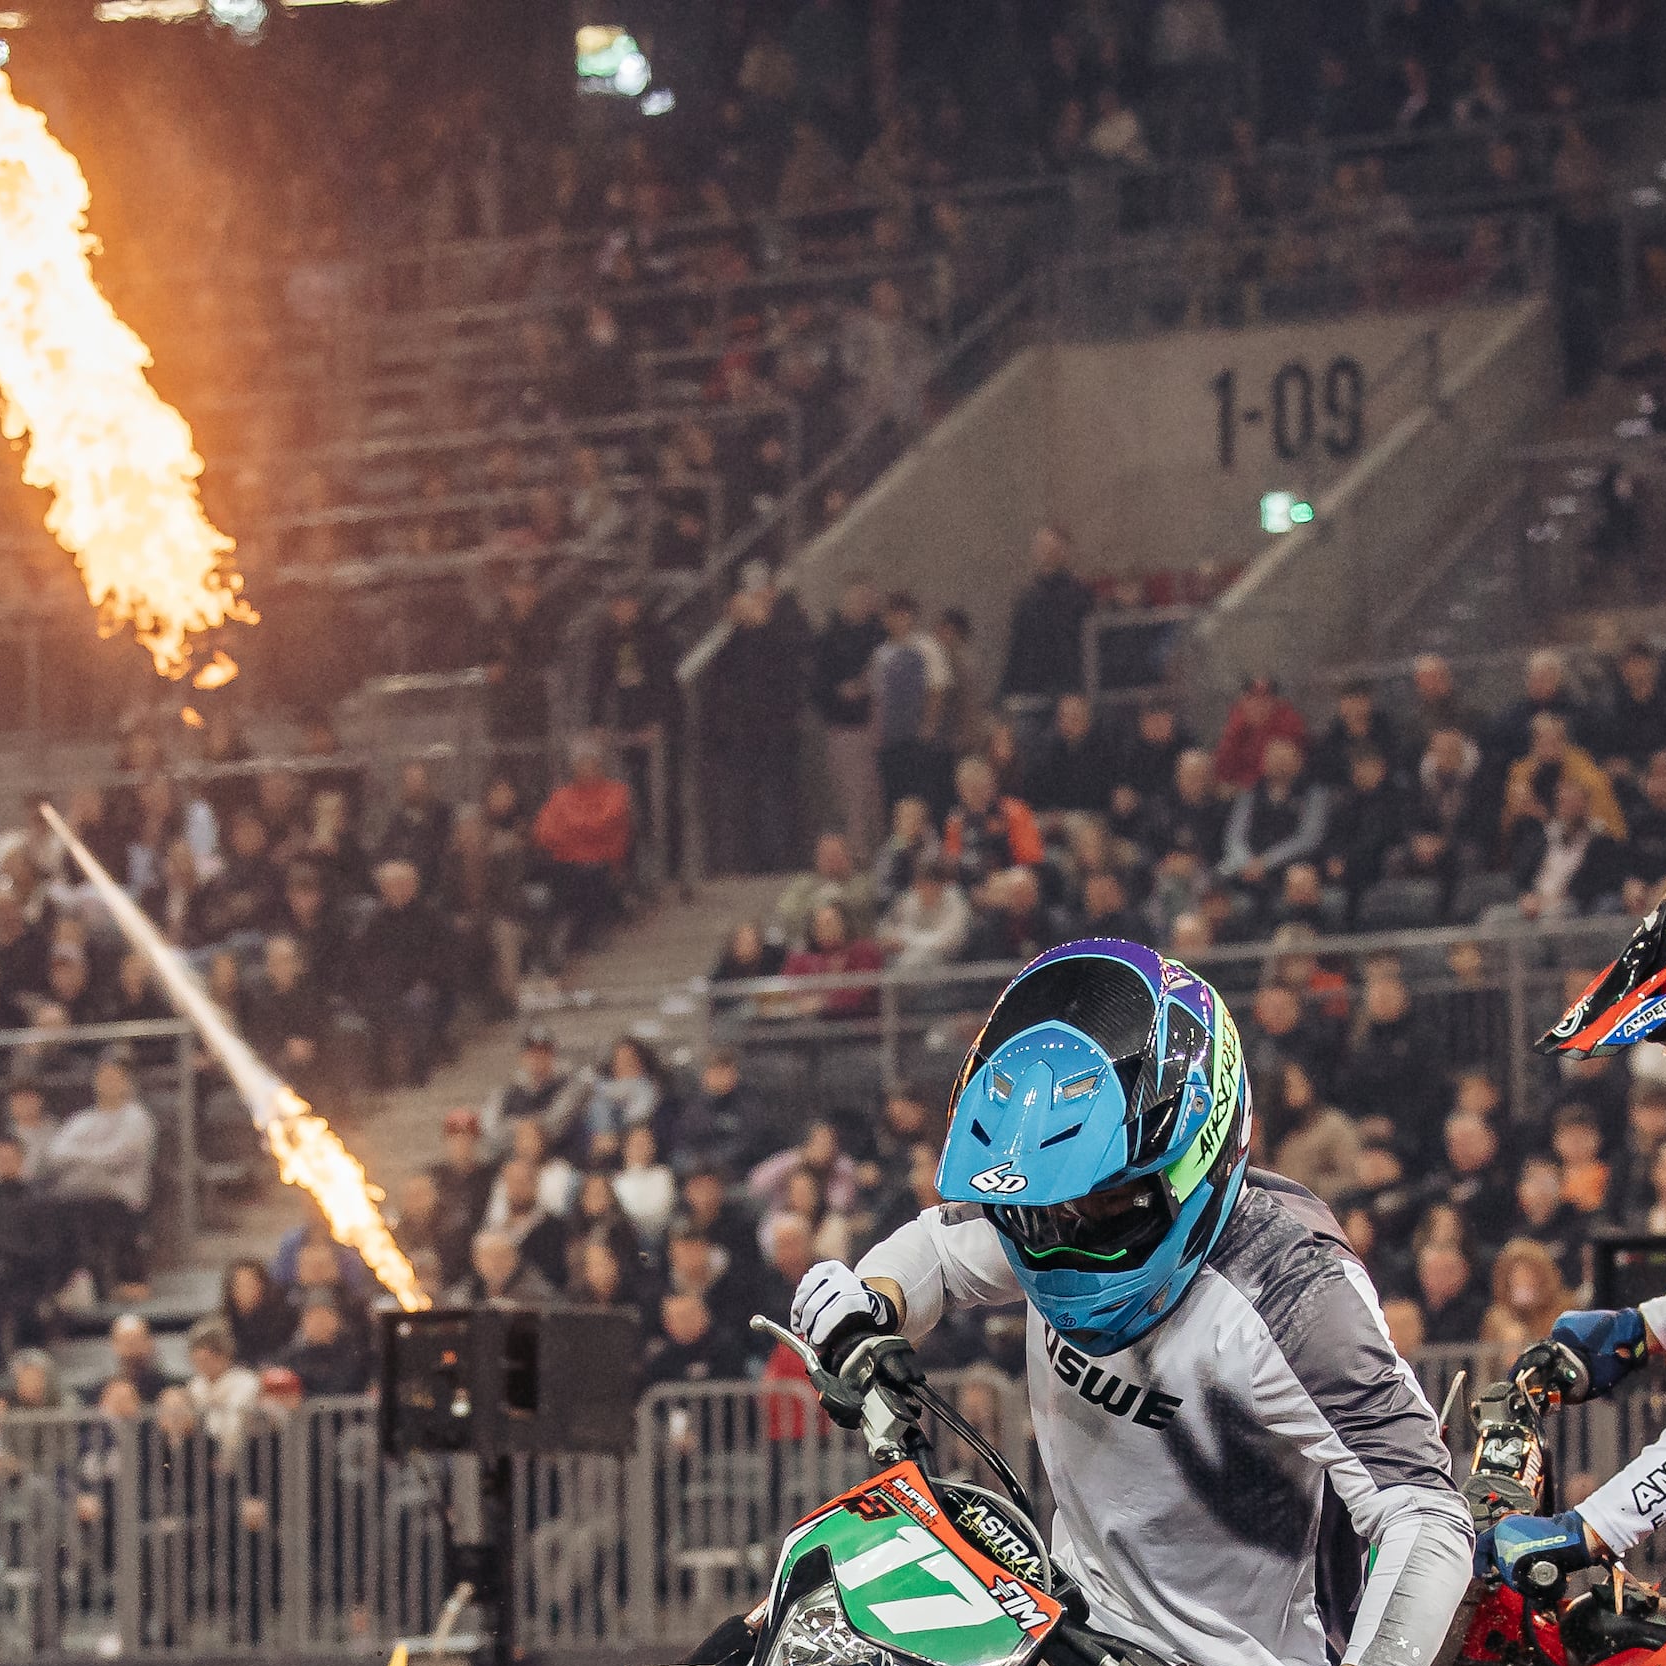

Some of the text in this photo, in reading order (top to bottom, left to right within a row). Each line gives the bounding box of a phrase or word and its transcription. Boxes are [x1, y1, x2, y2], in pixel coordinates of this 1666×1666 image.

[1205, 358, 1366, 468] 1-09
[969, 1161, 1028, 1194] 6D
[892, 1478, 938, 1518] SUPER
[957, 1513, 1028, 1581] OFFROAD
[834, 1525, 1006, 1635] 17
[989, 1575, 1050, 1631] FIM
